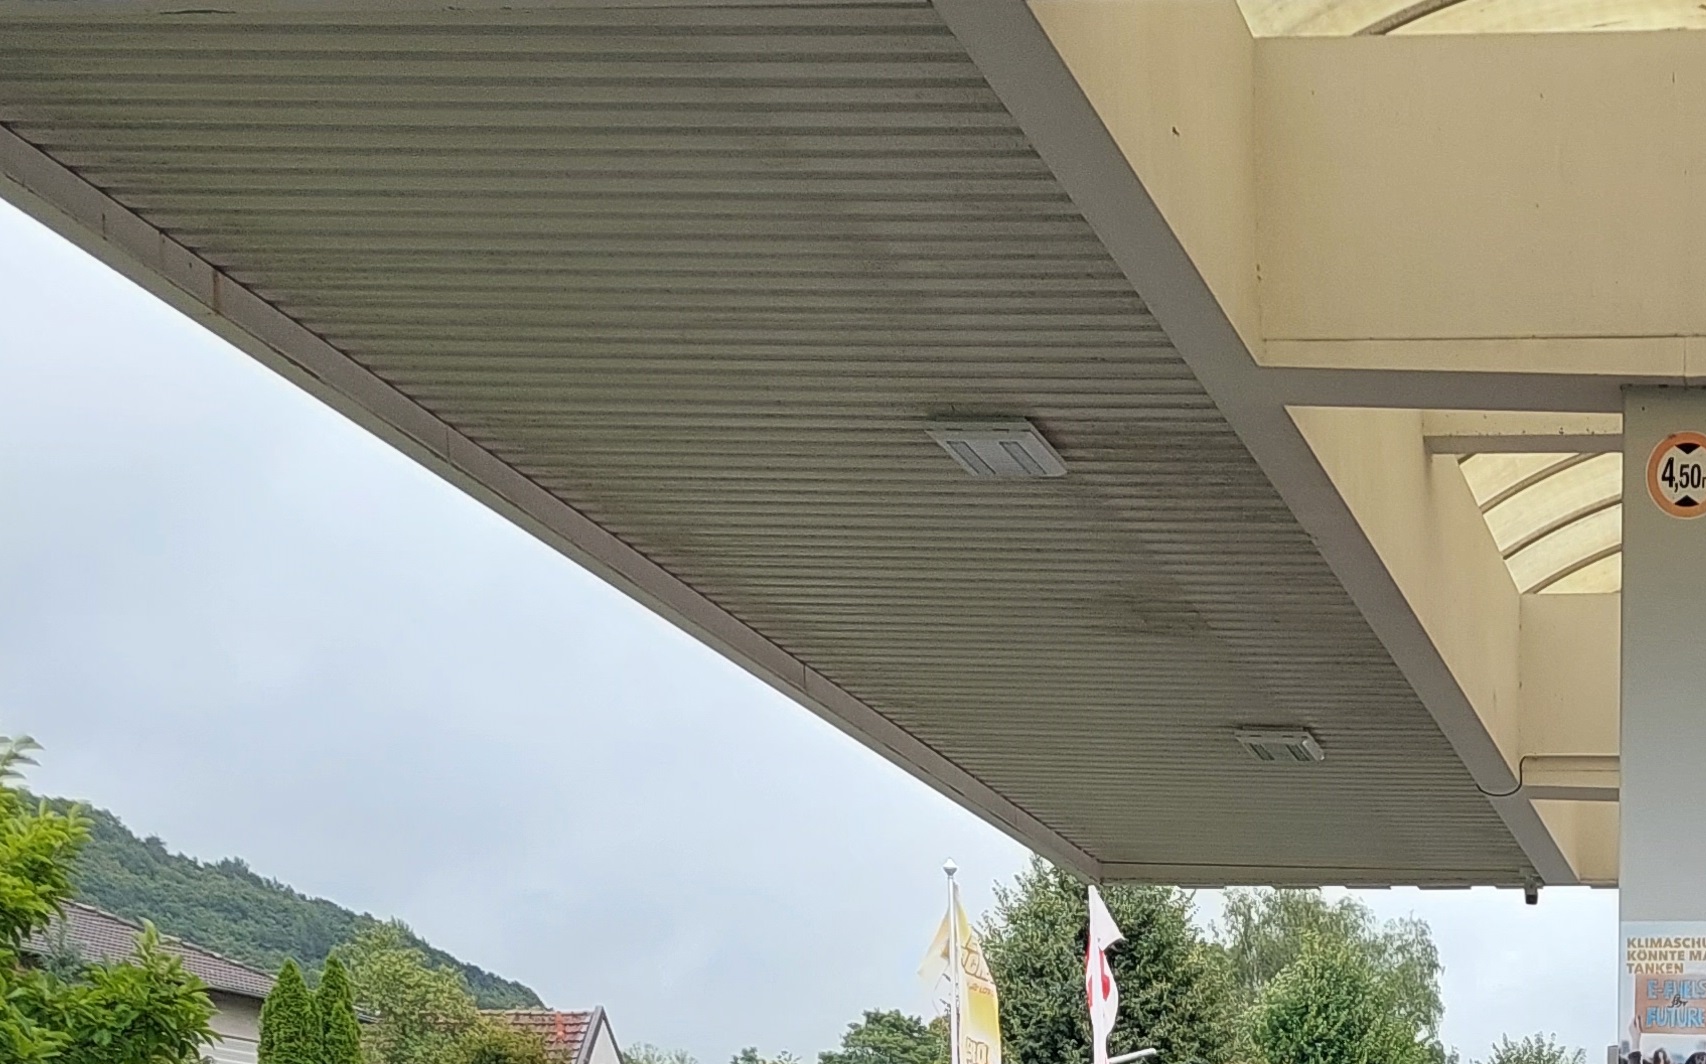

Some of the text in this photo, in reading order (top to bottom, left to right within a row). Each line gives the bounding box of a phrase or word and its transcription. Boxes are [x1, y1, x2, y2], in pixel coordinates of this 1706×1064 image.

[1627, 949, 1685, 961] KÖNNTE
[1626, 962, 1684, 975] TANKEN
[1667, 994, 1688, 1008] for
[1645, 1006, 1706, 1028] FUTURE
